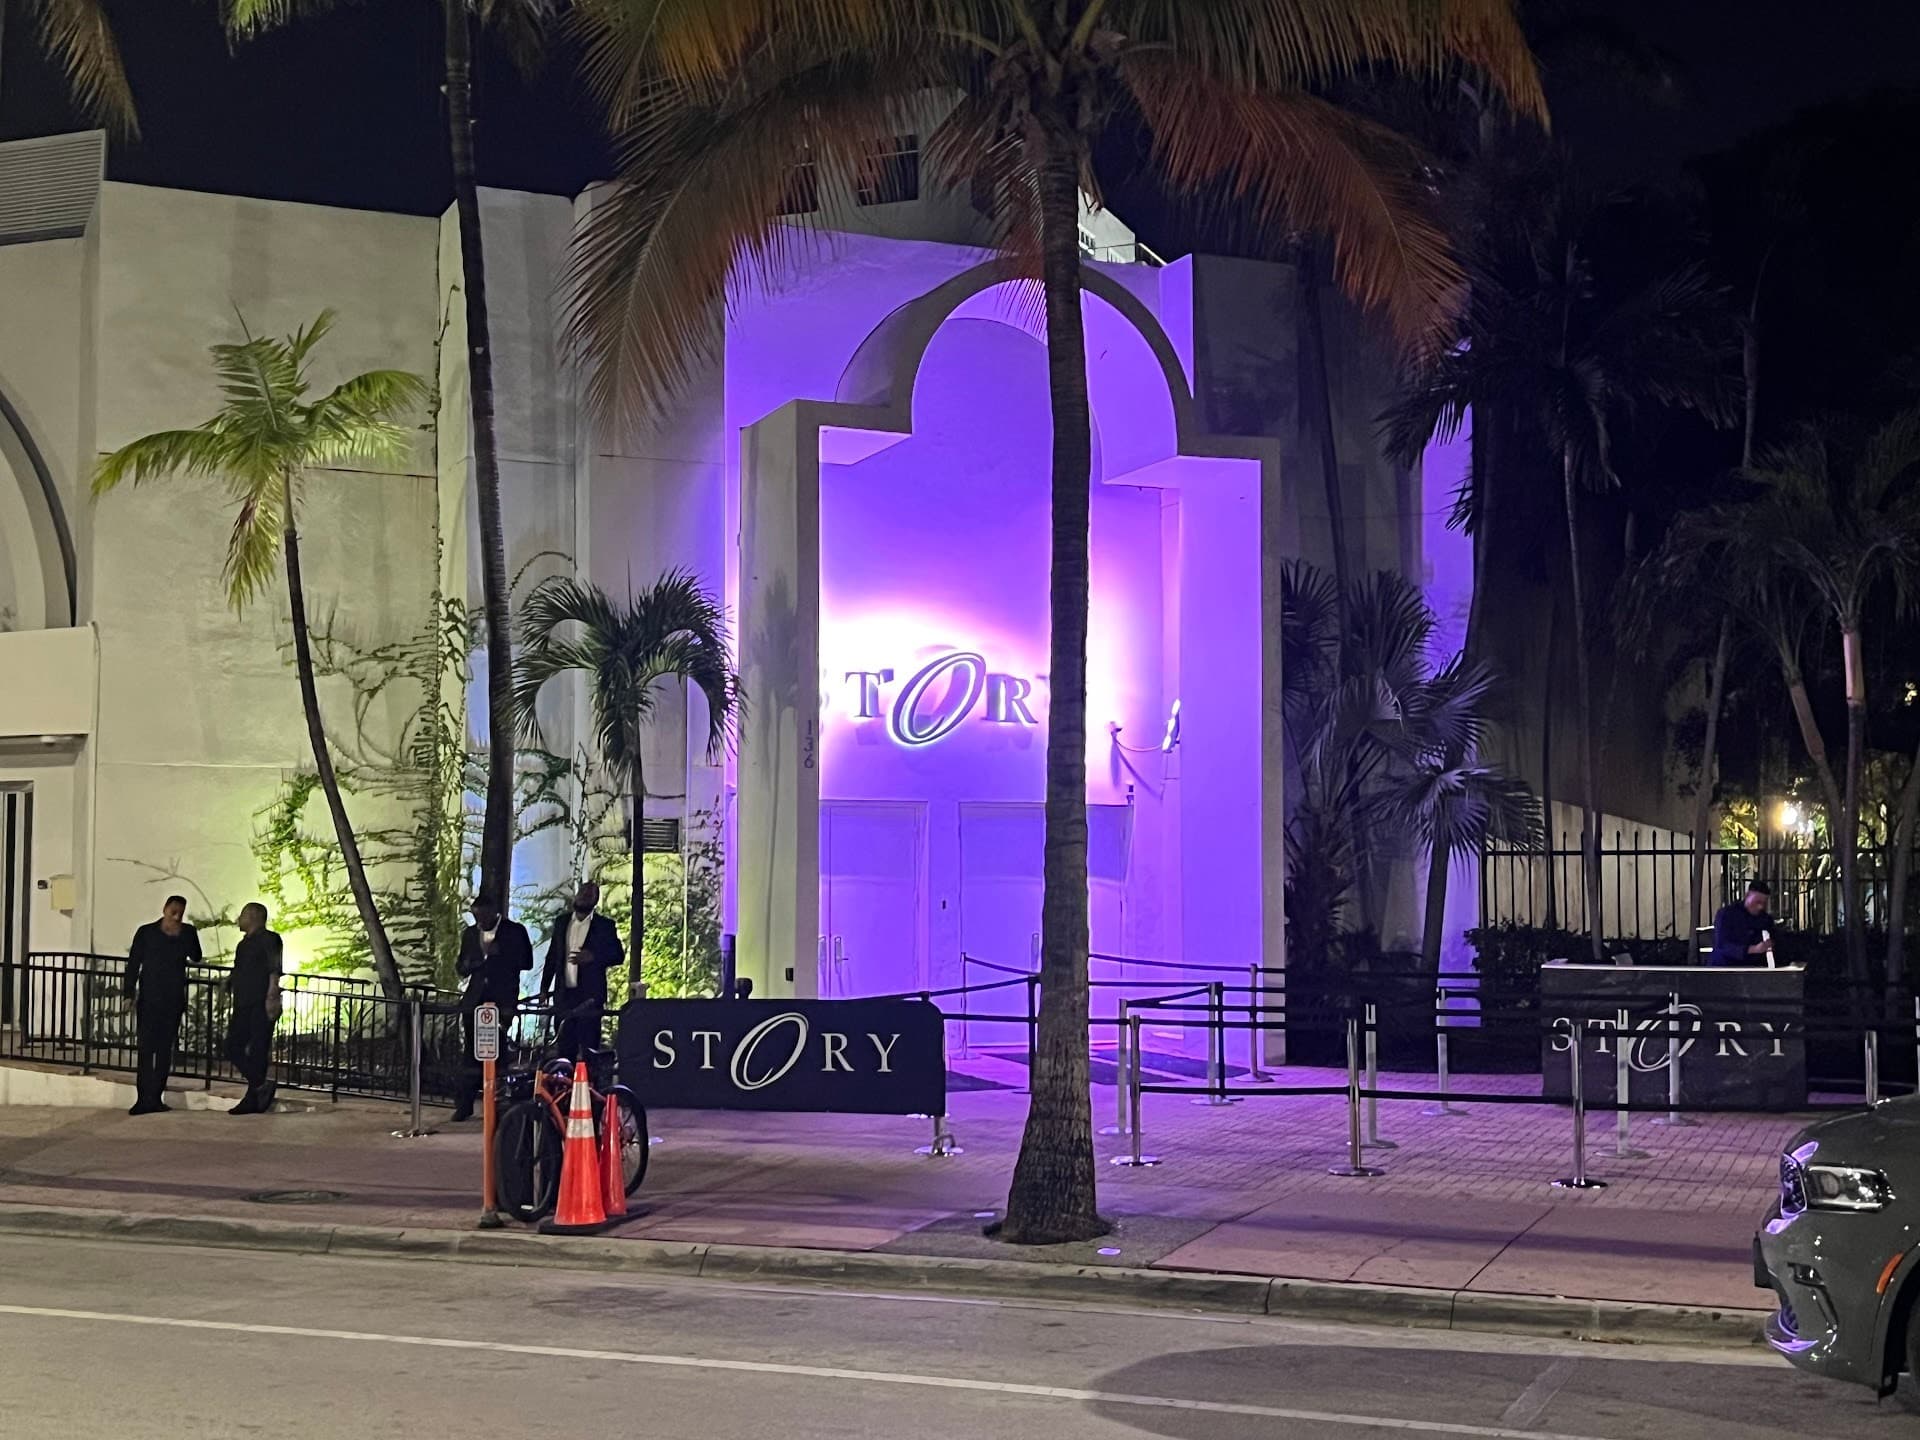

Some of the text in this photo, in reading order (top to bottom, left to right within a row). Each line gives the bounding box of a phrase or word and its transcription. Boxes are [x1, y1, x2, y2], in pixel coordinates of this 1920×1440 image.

[804, 719, 815, 769] 136
[652, 1011, 902, 1091] STORY
[1551, 1003, 1791, 1073] STORY
